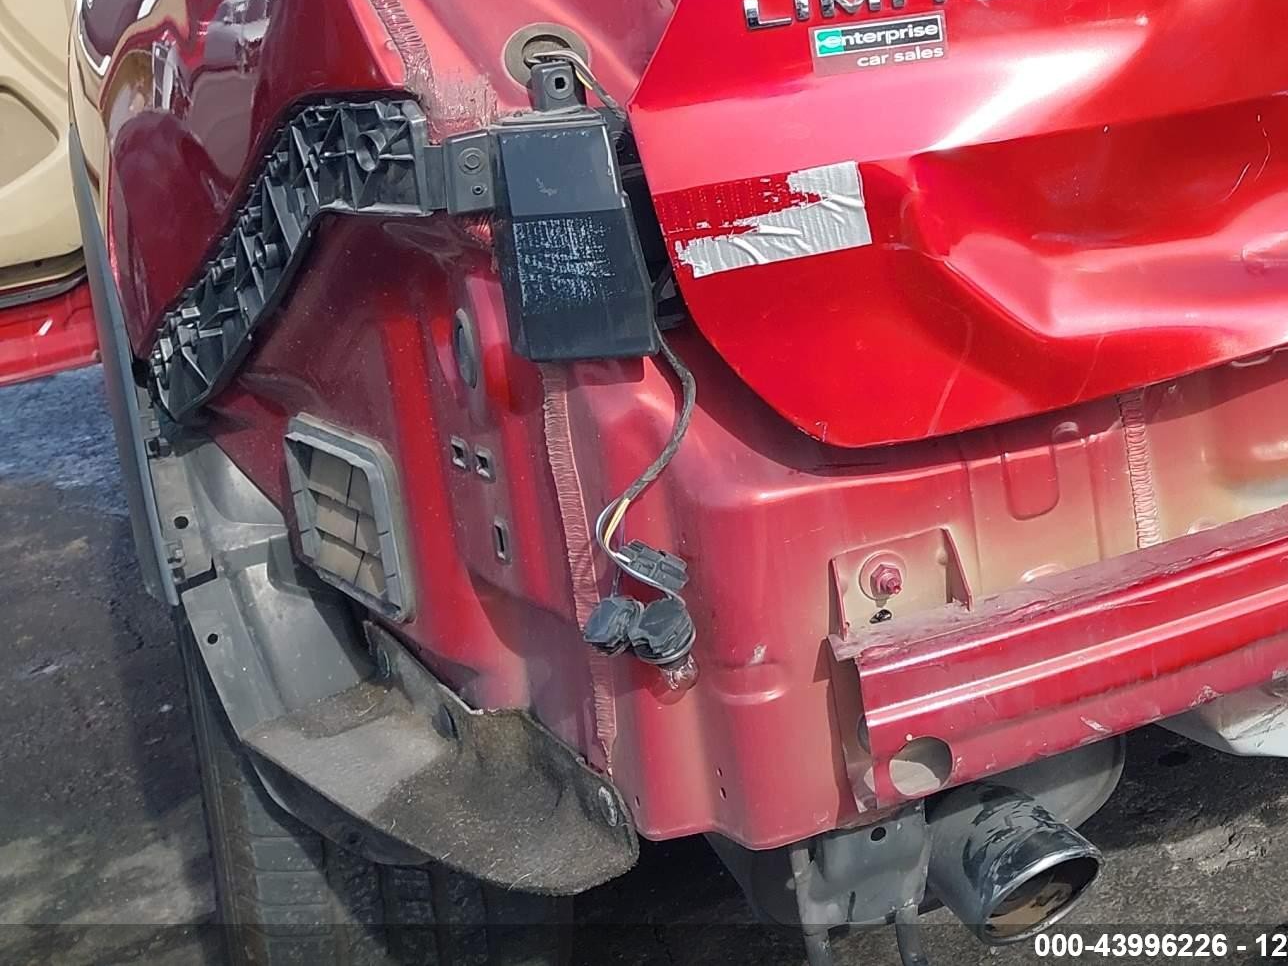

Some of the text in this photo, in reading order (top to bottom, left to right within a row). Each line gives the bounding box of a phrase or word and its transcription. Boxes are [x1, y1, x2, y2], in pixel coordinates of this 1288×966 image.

[821, 23, 939, 49] enterprise
[856, 45, 944, 67] car sales
